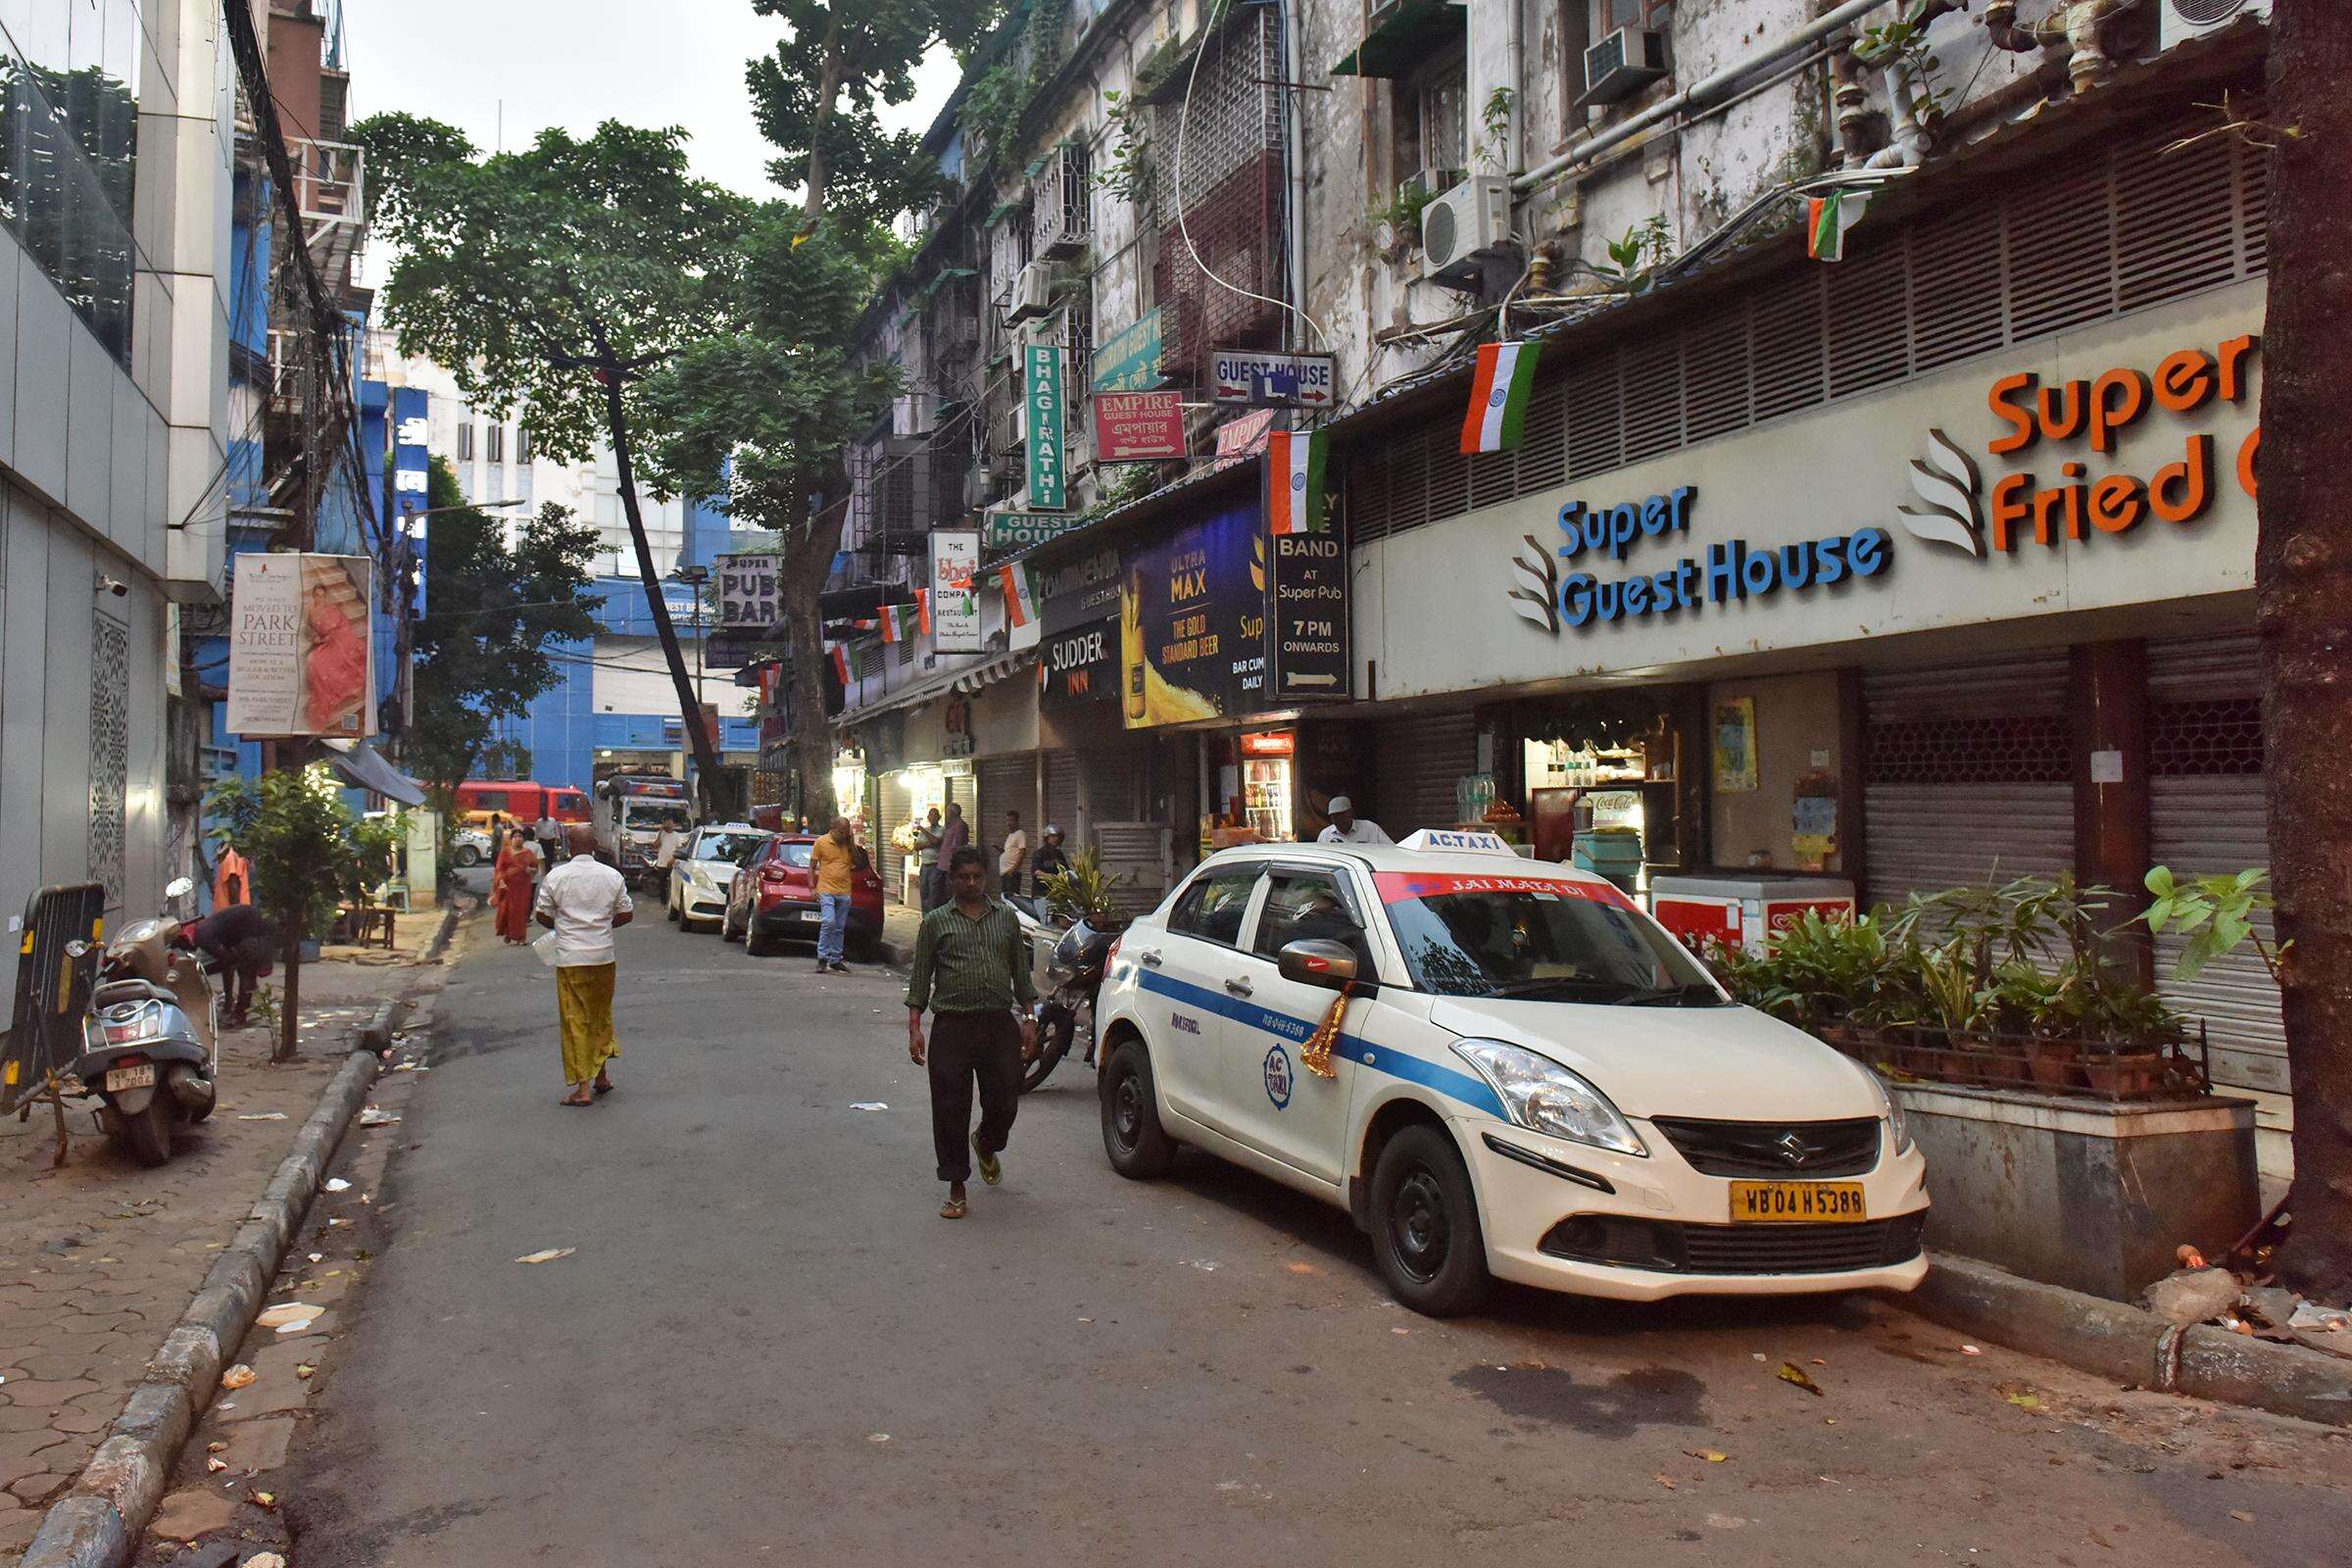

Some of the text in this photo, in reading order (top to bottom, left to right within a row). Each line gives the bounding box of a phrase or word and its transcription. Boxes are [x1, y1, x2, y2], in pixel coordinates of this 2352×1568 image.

[1988, 334, 2257, 454] Super
[1102, 395, 1174, 413] EMPIRE
[1103, 409, 1174, 420] GUEST HOUSE
[1036, 349, 1055, 504] BHAGIRATHI
[1992, 434, 2209, 552] Fried
[1007, 516, 1075, 528] GUEST
[1558, 485, 1694, 561] Super
[996, 528, 1064, 543] HOU
[948, 543, 964, 552] THE
[1279, 539, 1339, 558] BAND
[1303, 569, 1318, 580] AT
[1558, 526, 1889, 627] Guest House
[722, 574, 776, 597] PUB
[1170, 568, 1207, 604] MAX
[1279, 584, 1343, 602] Super Pub
[244, 613, 296, 630] PARK
[722, 601, 776, 623] BAR
[1173, 613, 1206, 640] THE GOLD
[1240, 614, 1263, 639] Sup
[1293, 620, 1332, 637] 7 PM
[239, 631, 299, 646] STREET
[1284, 641, 1340, 653] ONWARDS
[1053, 631, 1103, 672] SUDDER
[1162, 634, 1219, 664] STANDARD BEER
[1233, 657, 1264, 674] BAR CUM
[1067, 668, 1089, 697] INN
[1243, 675, 1263, 690] DAILY
[1452, 878, 1589, 897] JAI MATA DI
[1268, 1055, 1284, 1072] AC
[1268, 1075, 1288, 1097] TAXI
